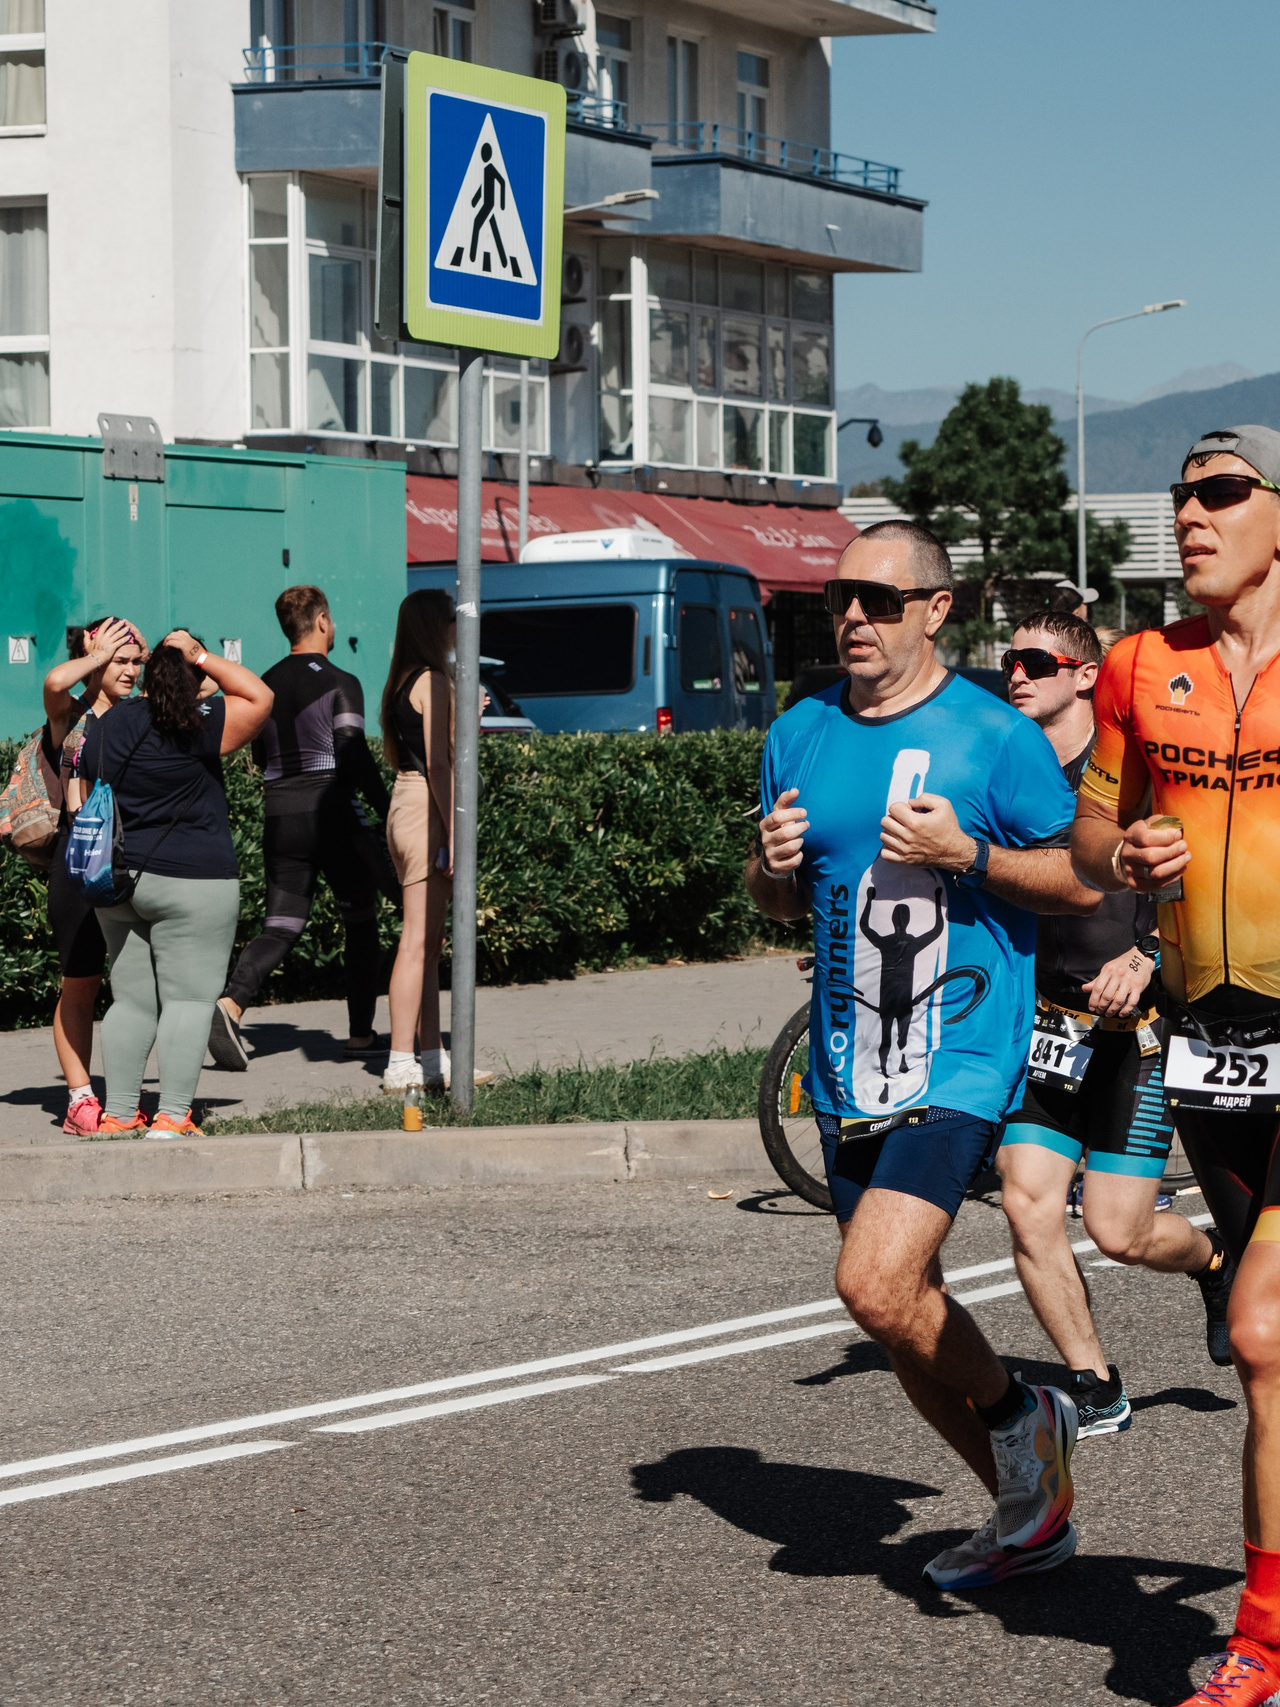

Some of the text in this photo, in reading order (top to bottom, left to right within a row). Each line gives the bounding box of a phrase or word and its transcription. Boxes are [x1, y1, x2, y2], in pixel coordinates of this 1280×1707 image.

[1155, 704, 1201, 716] РОСНЕФТЬ
[1128, 955, 1143, 972] 841
[1031, 1037, 1067, 1069] 841
[1202, 1049, 1269, 1087] 252
[1213, 1094, 1252, 1109] АНДРЕЙ
